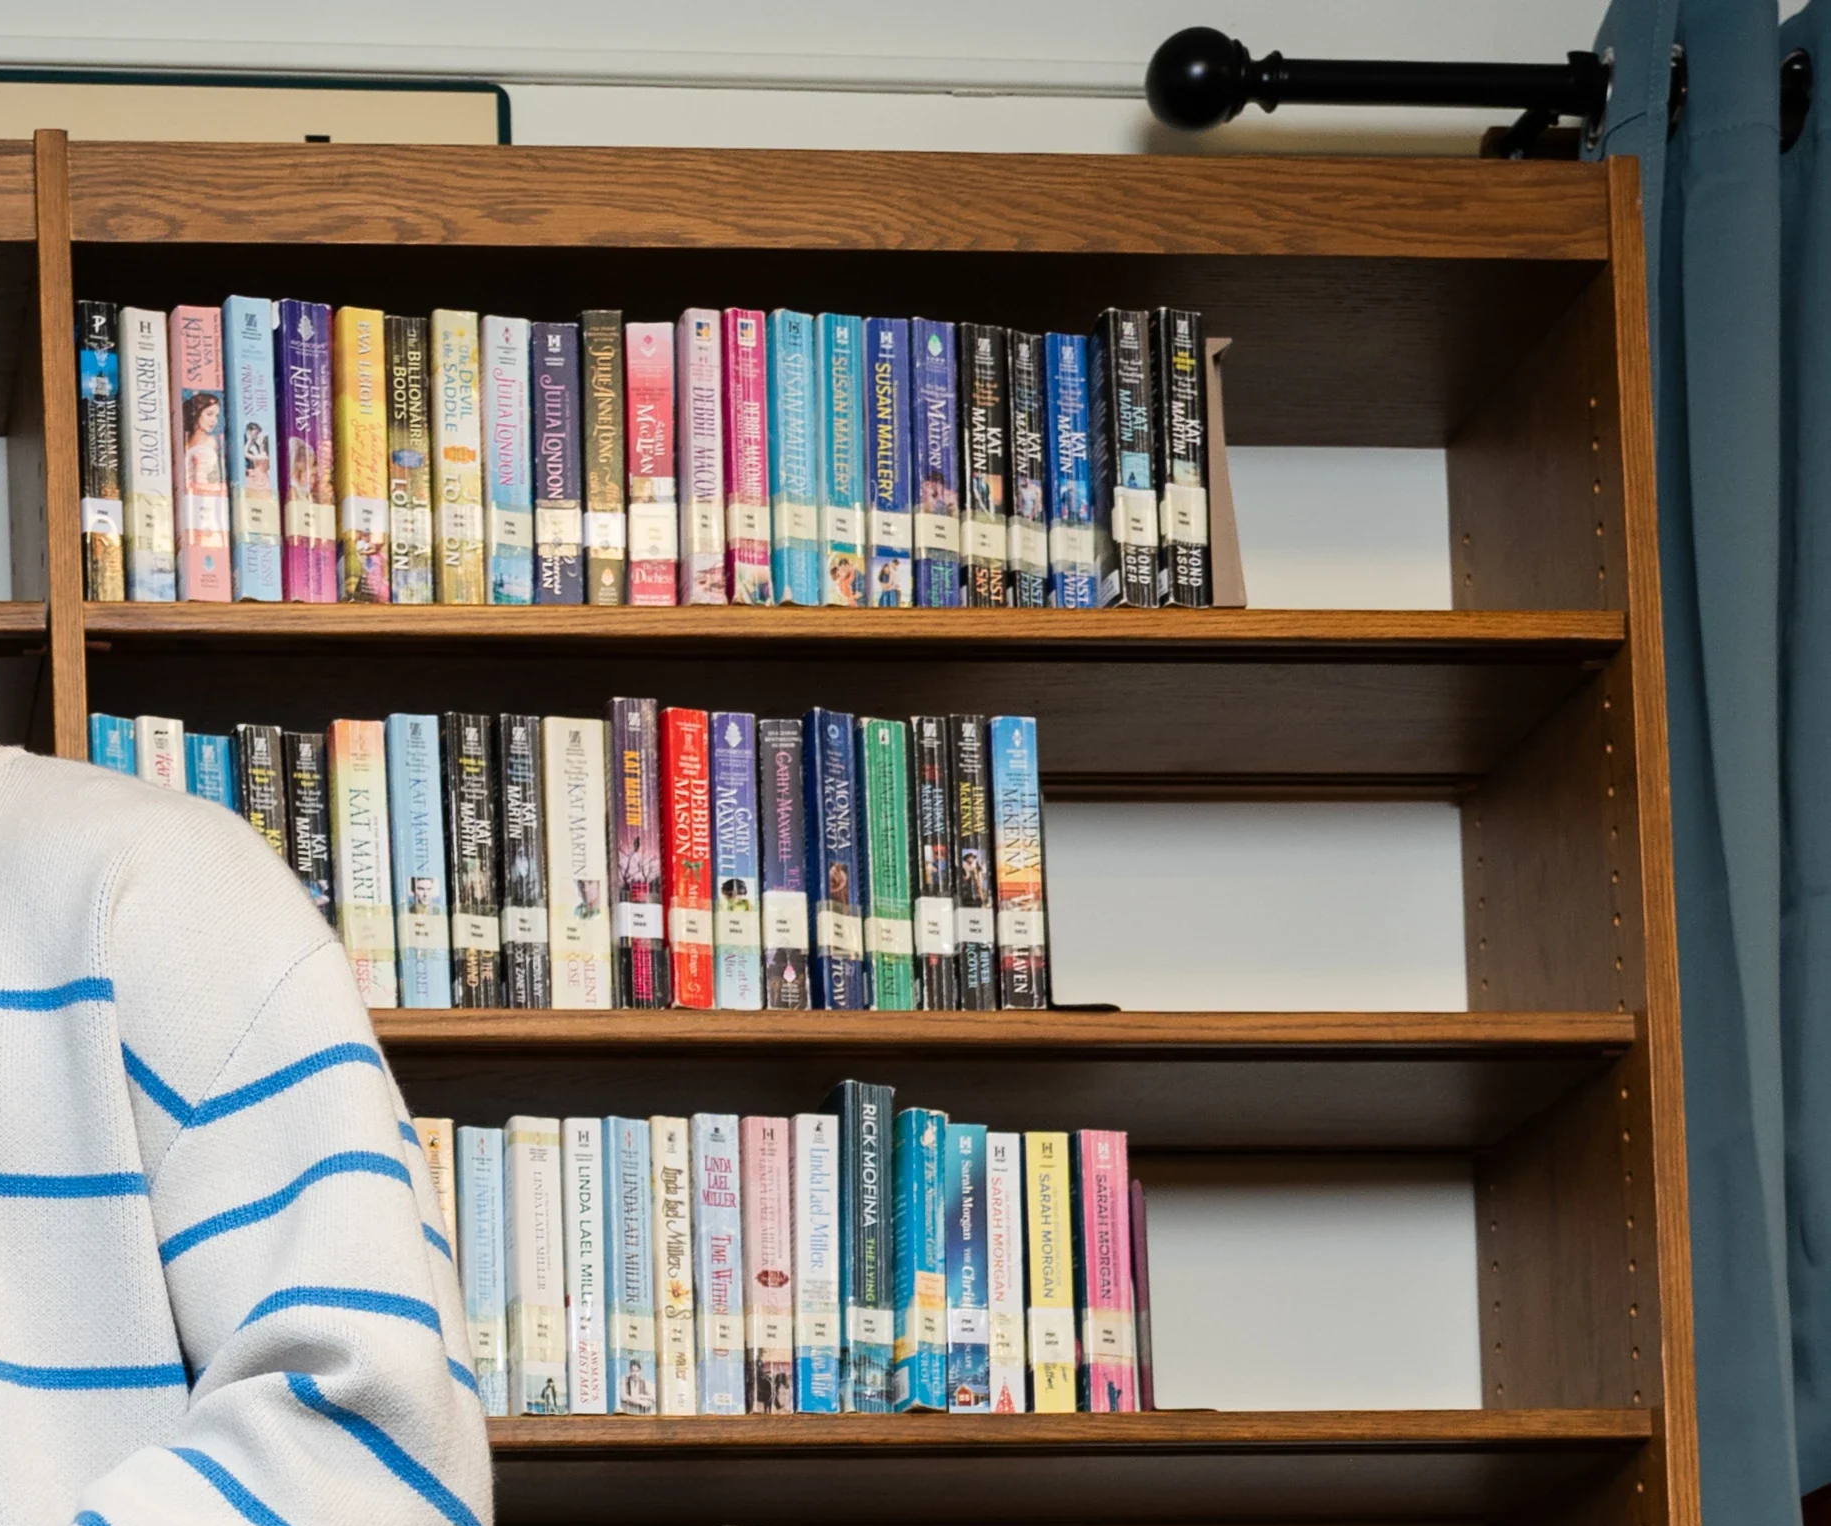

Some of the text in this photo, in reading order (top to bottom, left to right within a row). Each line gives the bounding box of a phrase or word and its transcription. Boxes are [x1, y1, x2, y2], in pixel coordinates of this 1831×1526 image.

[135, 356, 159, 475] BRENDA JOYCE
[392, 366, 407, 420] BOOTS
[875, 363, 892, 500] SUSAN MALLERY
[1172, 401, 1185, 455] MARTIN
[1186, 420, 1200, 445] KAT
[625, 750, 641, 825] KAT MARTIN
[674, 776, 690, 855] MASON
[691, 778, 708, 858] DEBBIE
[863, 1103, 878, 1227] RICK MOFINA
[960, 1160, 973, 1240] Sarah Morgan
[577, 1166, 591, 1258] LINDA LAEL
[1096, 1174, 1111, 1300] SARAH MORGAN
